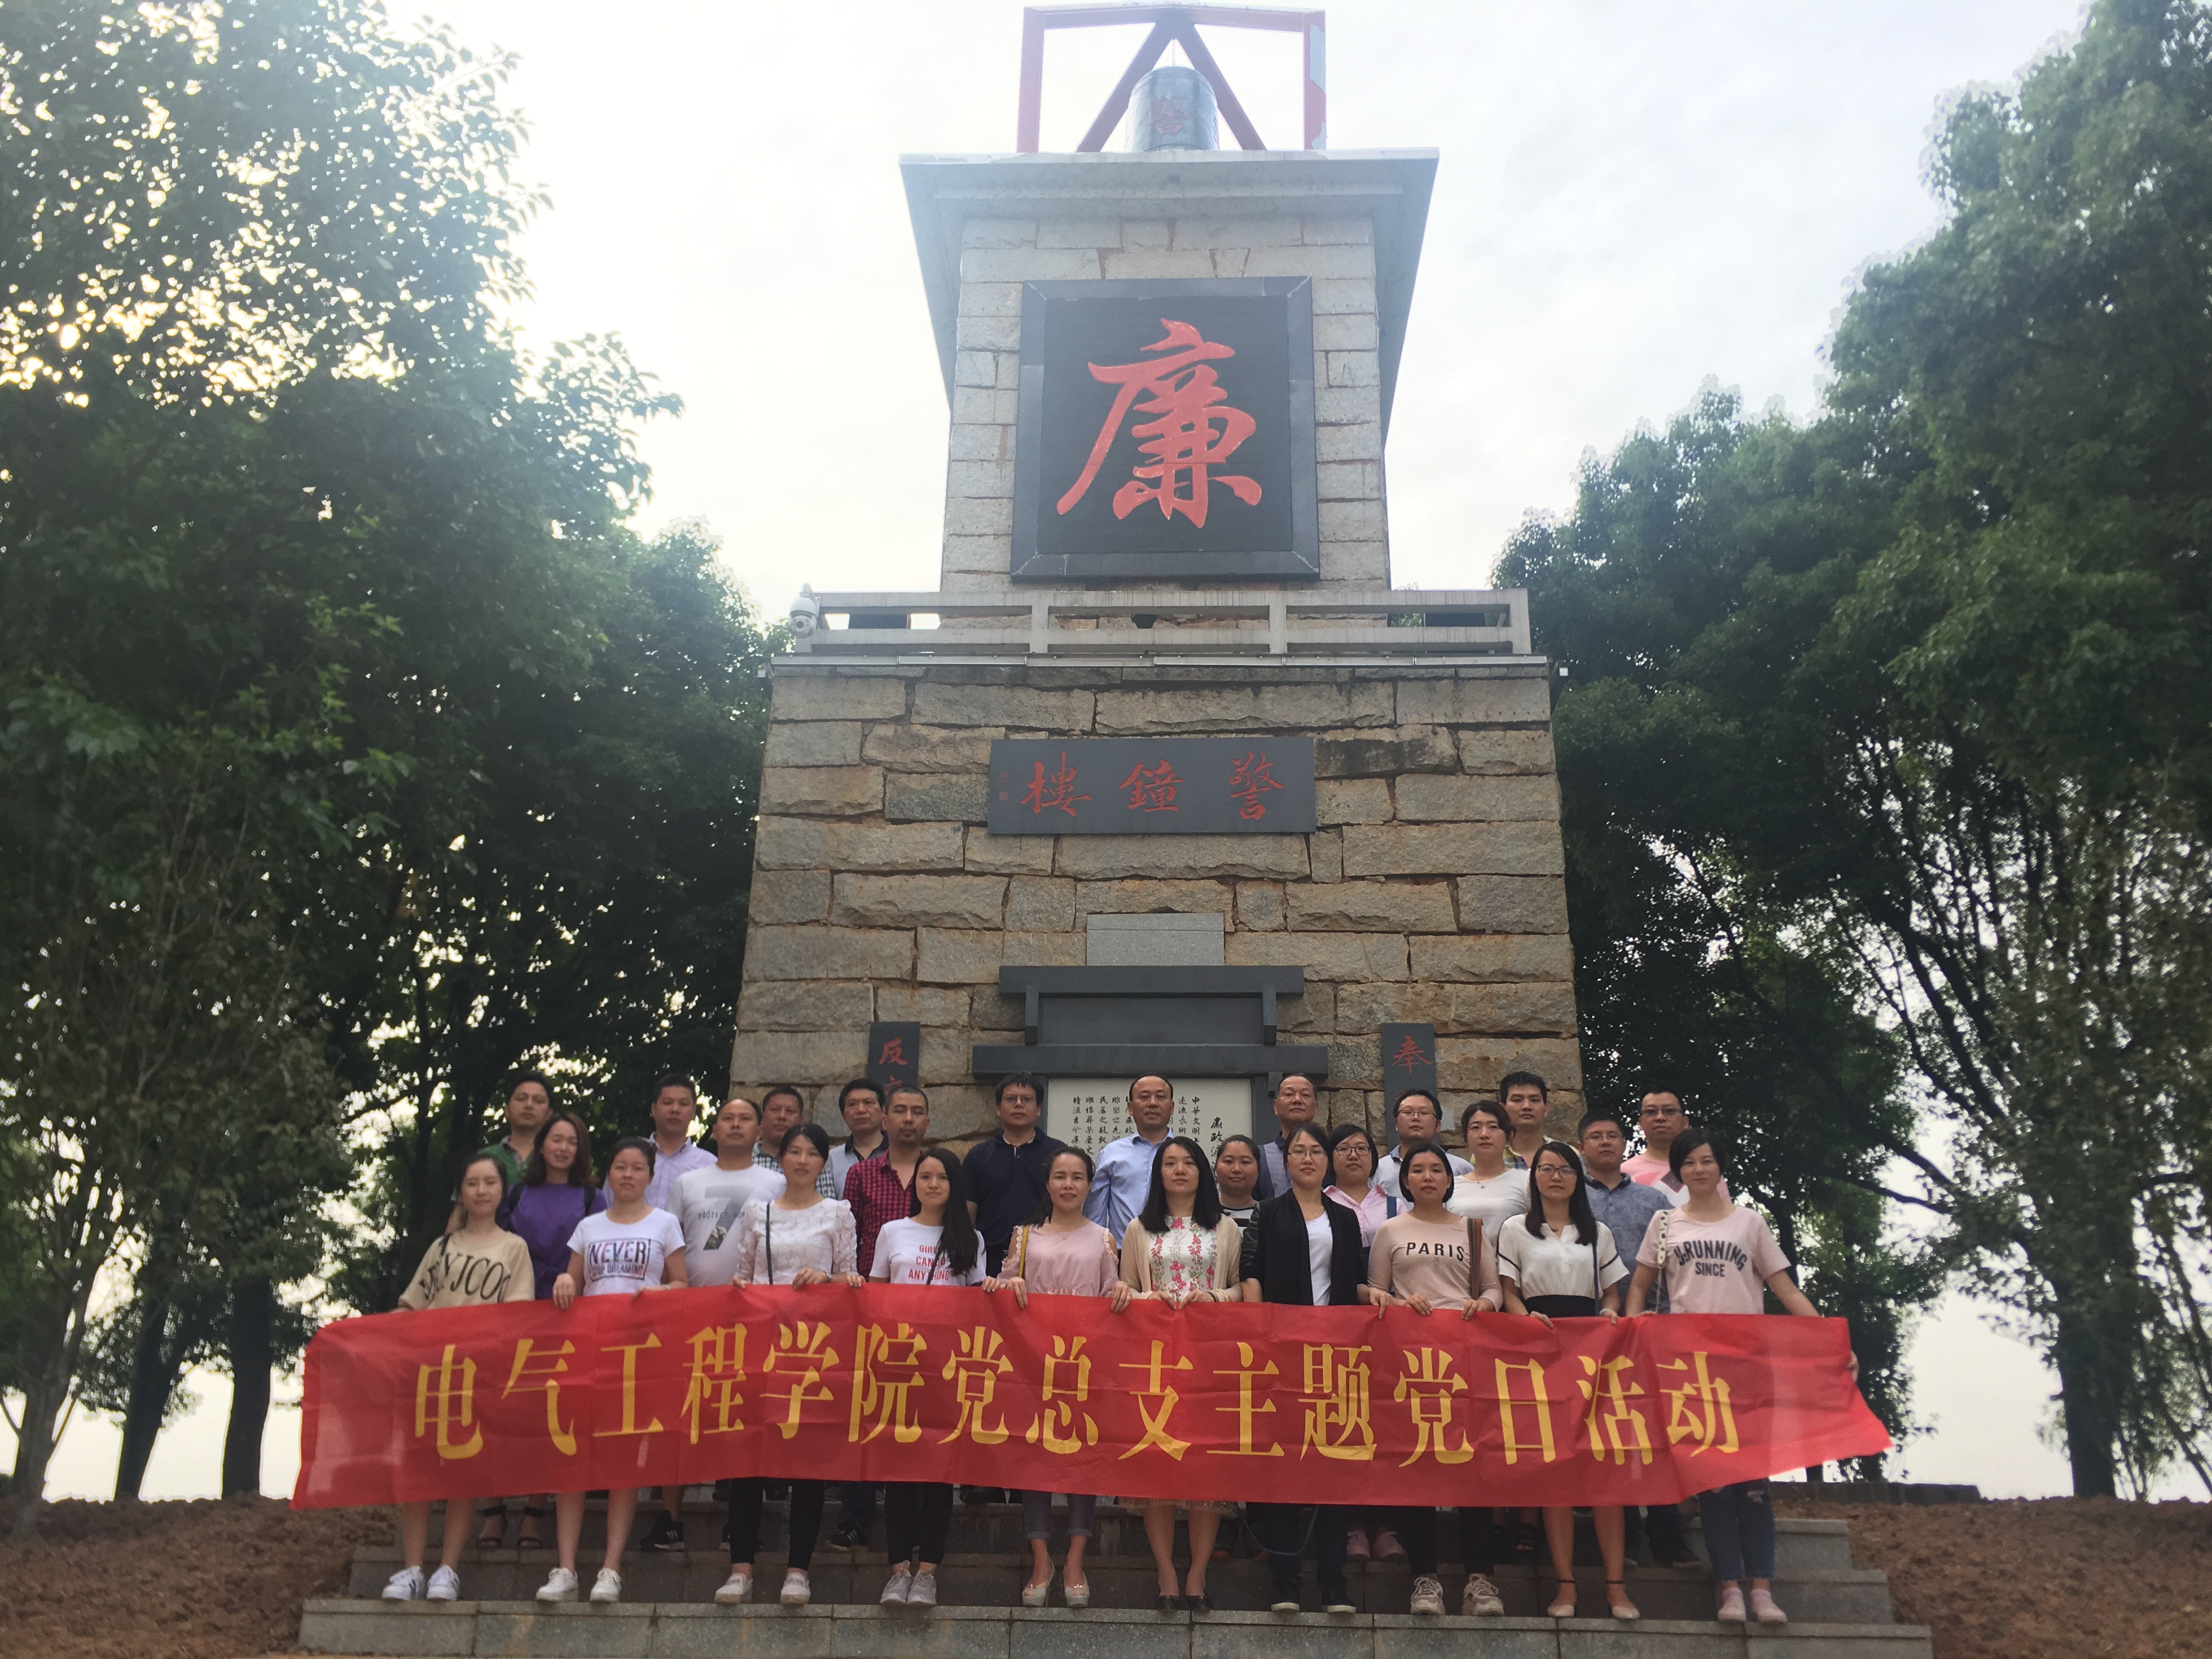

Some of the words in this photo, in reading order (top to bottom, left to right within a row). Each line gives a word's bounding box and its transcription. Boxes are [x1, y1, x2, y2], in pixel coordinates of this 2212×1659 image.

[1056, 318, 1262, 528] 廉
[1392, 1034, 1432, 1099] 奉
[589, 1241, 646, 1265] NEVER
[916, 1255, 934, 1267] CAN
[1406, 1242, 1465, 1262] PARIS
[908, 1268, 950, 1281] ANYHING
[1695, 1262, 1725, 1278] SINCE
[414, 1321, 1740, 1468] 电气工程学院党总支主题党日活动
